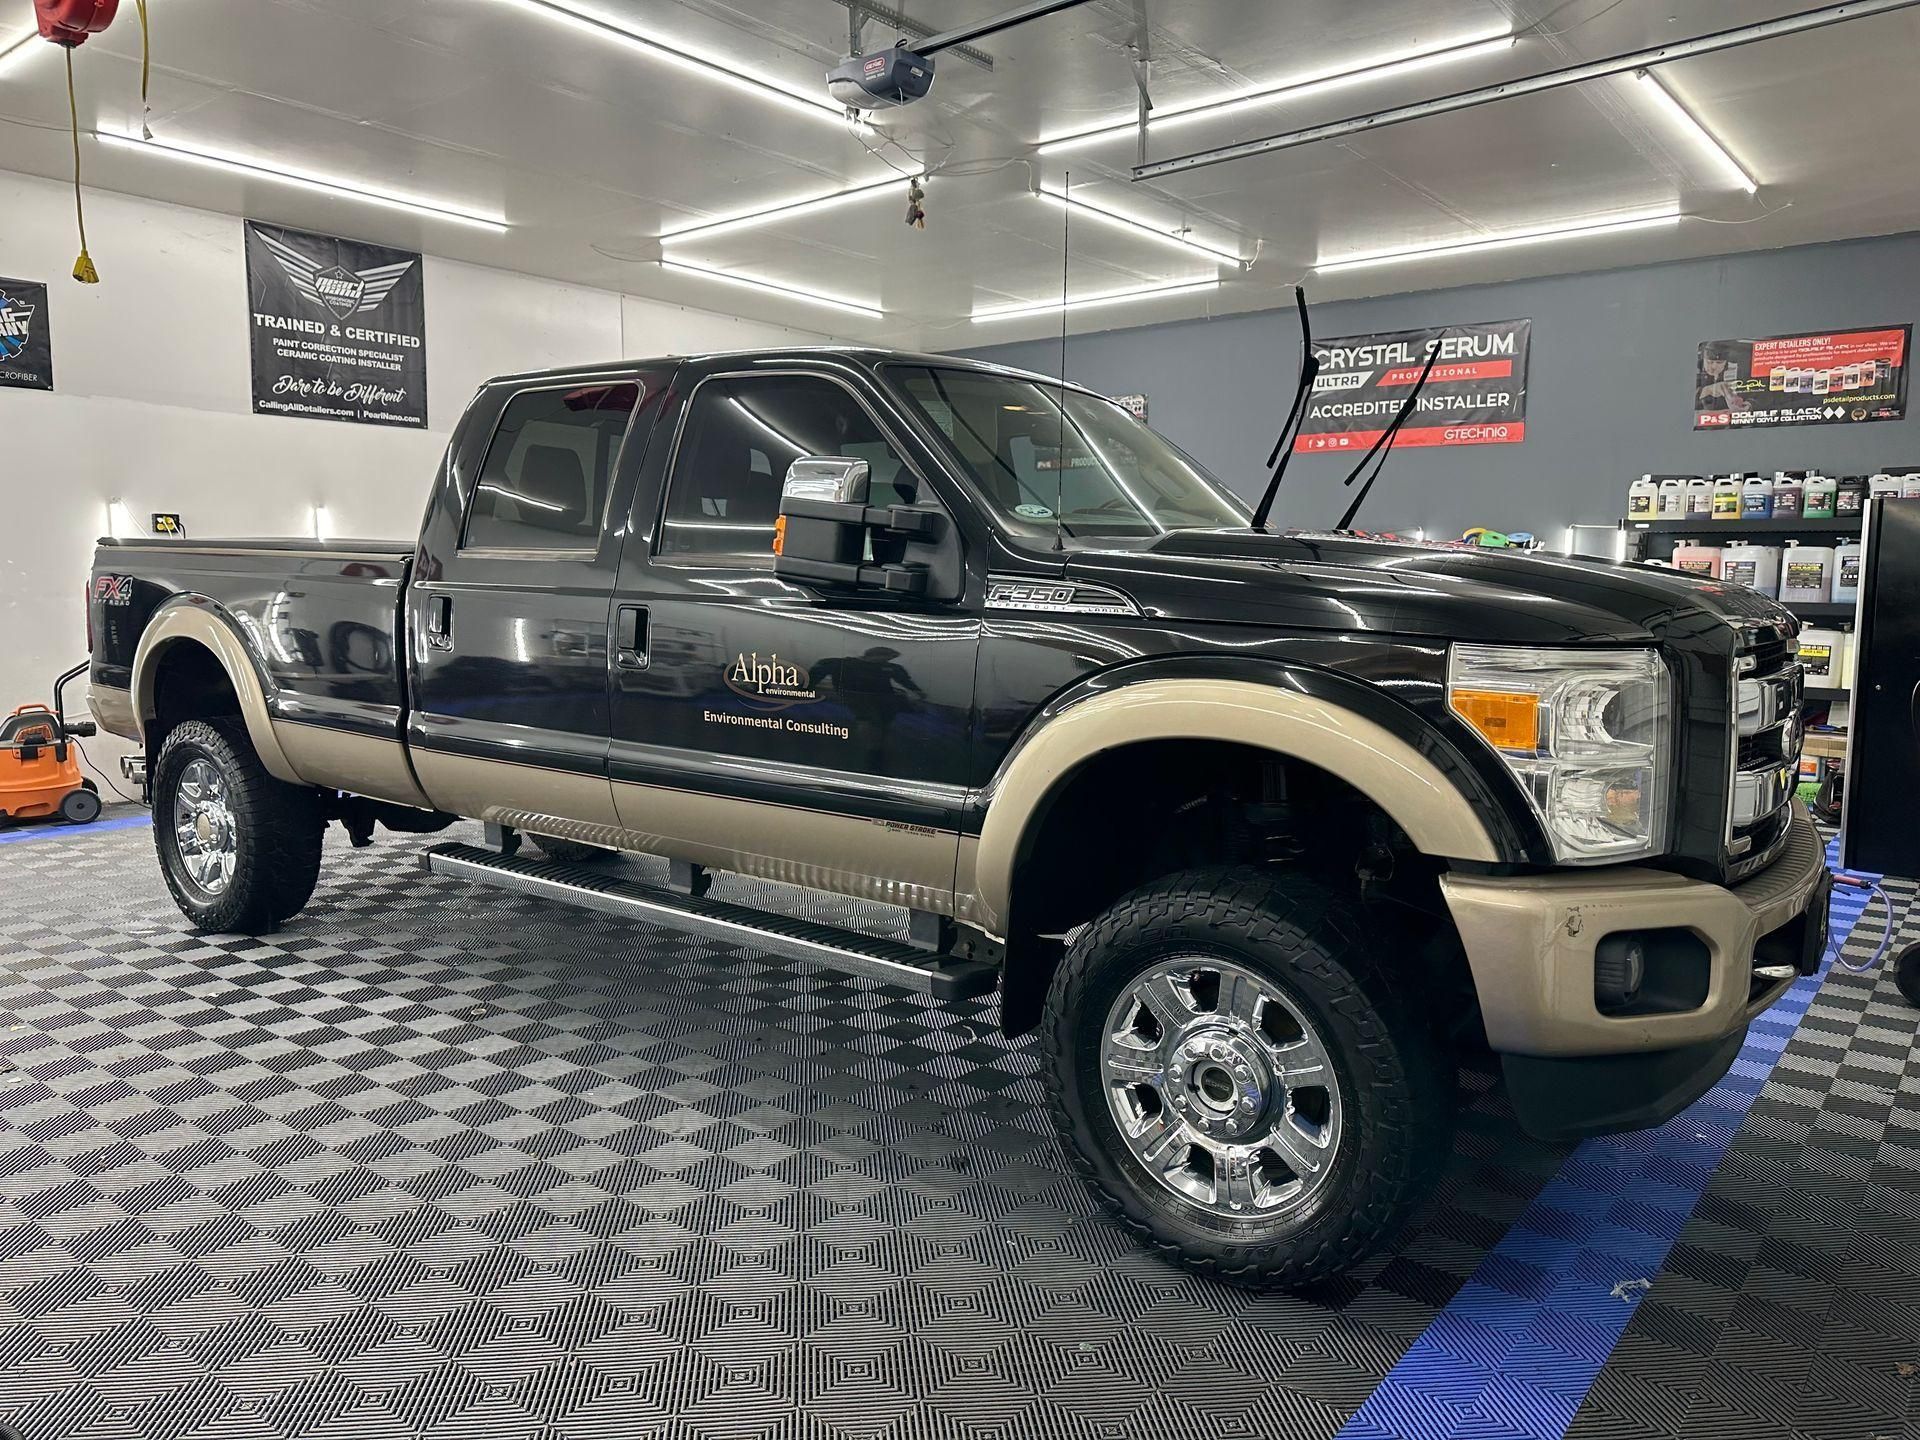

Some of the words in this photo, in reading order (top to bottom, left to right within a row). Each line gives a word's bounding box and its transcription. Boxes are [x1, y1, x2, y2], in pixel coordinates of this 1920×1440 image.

[253, 313, 325, 334] TRAINED
[329, 325, 341, 337] &
[345, 327, 420, 348] CERTIFIED
[272, 338, 300, 348] PAINT
[301, 341, 357, 356] CORRECTION
[358, 349, 404, 362] SPECIALIST
[1314, 342, 1415, 370] CRYSTAL
[1423, 332, 1514, 362] SERUM
[1755, 341, 1777, 351] EXPERT
[1778, 339, 1811, 349] DETAILERS
[1812, 337, 1831, 346] ONLY!
[277, 349, 317, 360] CERAMIC
[319, 352, 356, 365] COATING
[358, 359, 402, 371] INSTALLER
[1316, 375, 1360, 388] ULTRA
[1391, 367, 1477, 381] PROFSSIONAL
[272, 375, 312, 397] Dare
[312, 378, 327, 394] to
[327, 382, 344, 396] be
[343, 383, 406, 406] Different
[1822, 392, 1896, 405] psdetailproducts.com
[258, 400, 354, 417] CallingAllDetailers.com
[363, 410, 421, 423] PearlNano.com
[1416, 393, 1510, 412] INSTALLER
[1700, 414, 1729, 425] P&S
[1731, 409, 1778, 419] DOUBLE
[1780, 407, 1822, 416] BLACK
[1780, 414, 1822, 422] COLLECTION
[1444, 426, 1508, 440] GTECHNIQ
[94, 576, 133, 599] FX4
[731, 652, 799, 694] Alpha
[765, 688, 816, 698] environmental
[704, 710, 783, 730] Environmental
[786, 719, 849, 740] Consulting
[885, 821, 909, 831] POWER
[909, 824, 937, 835] STROKE
